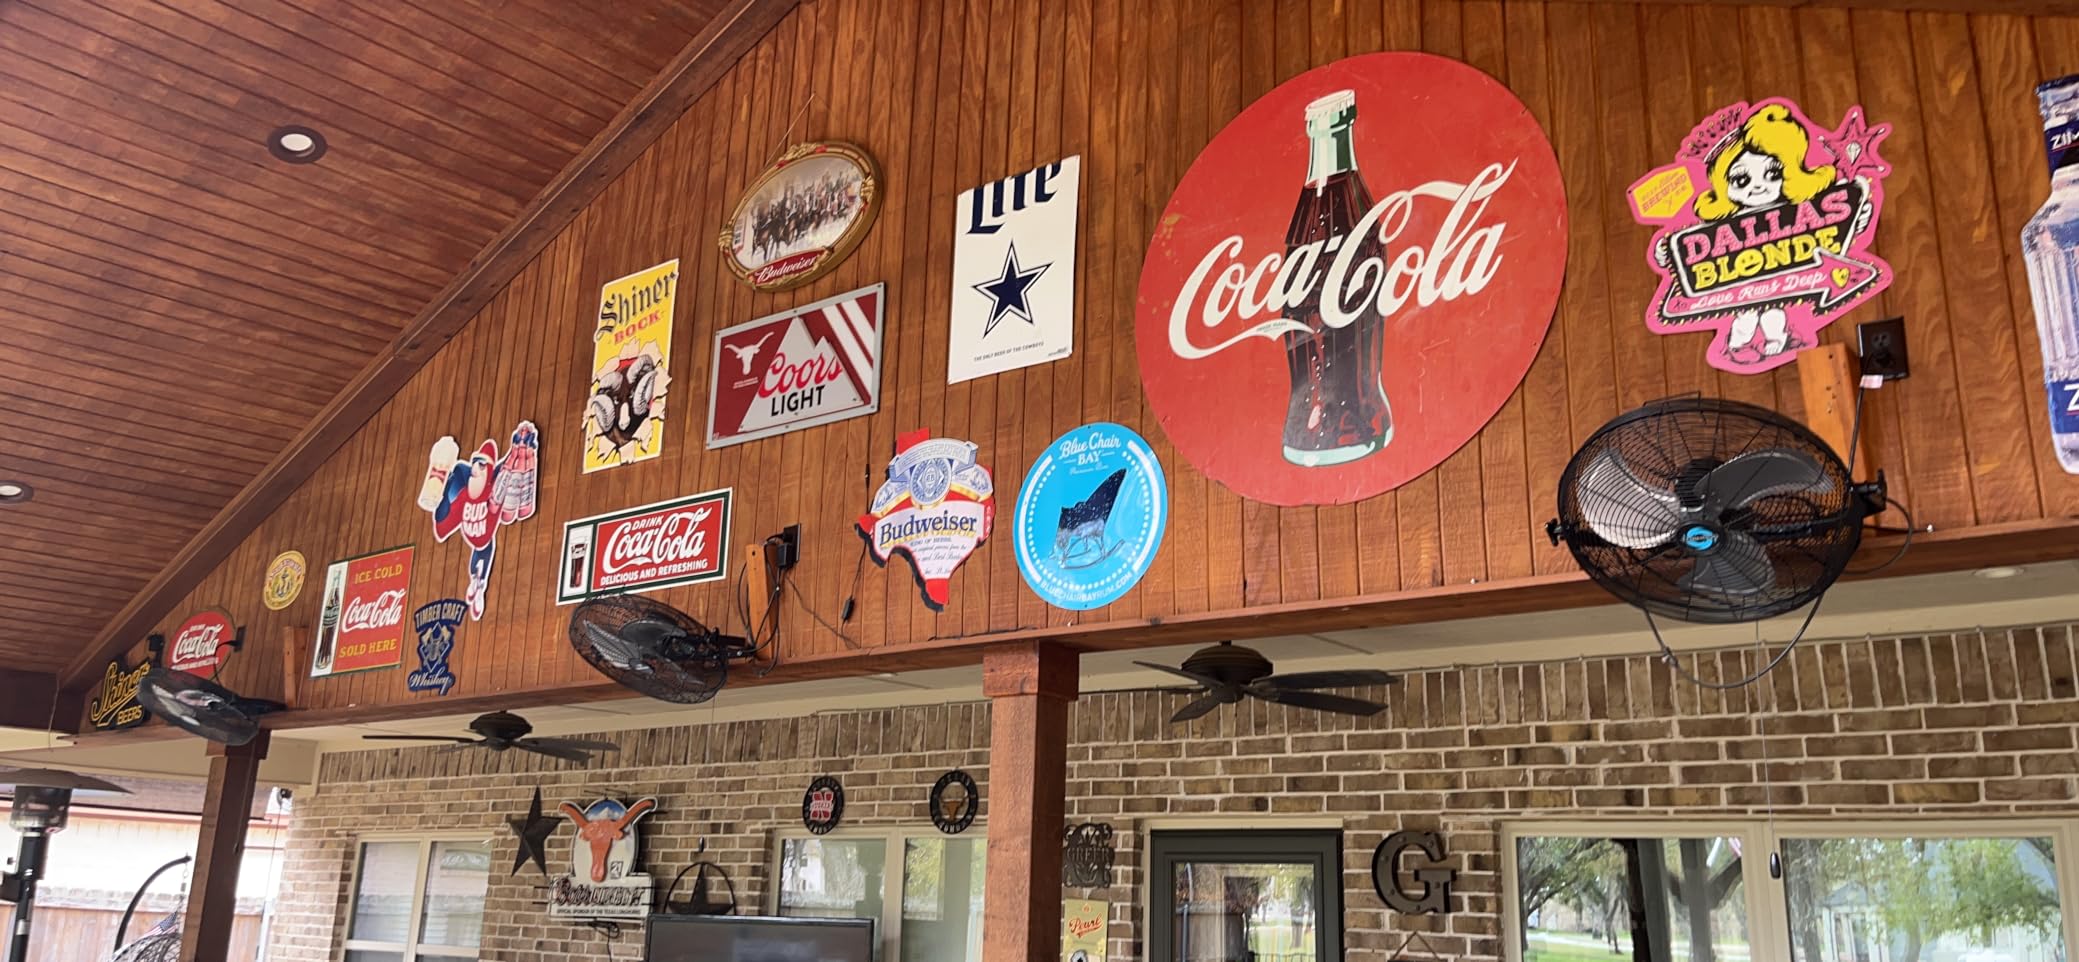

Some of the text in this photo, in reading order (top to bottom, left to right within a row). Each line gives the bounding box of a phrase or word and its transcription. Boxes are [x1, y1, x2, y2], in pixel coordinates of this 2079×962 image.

[1682, 190, 1852, 265] DALLAS
[755, 256, 817, 283] Budweiser
[1169, 157, 1519, 360] Coca-Cola
[596, 271, 676, 341] Shiner
[1690, 270, 1828, 311] Love Runs Deep
[614, 309, 660, 345] BOCK
[758, 352, 844, 398] Coors
[771, 385, 826, 417] LIGHT
[1058, 431, 1121, 459] Blue Chair
[1078, 450, 1101, 466] BAY
[462, 501, 489, 522] BUD
[631, 515, 663, 531] DRINK
[462, 520, 487, 537] MAN
[602, 507, 712, 574] Coca-Cola
[880, 510, 977, 547] Budweiser
[355, 564, 403, 584] ICE COLD
[600, 558, 708, 586] DELICIOUS AND REFRESHING
[341, 588, 406, 633] Coca-Cola
[415, 602, 467, 627] TIMBER CRAFT
[172, 623, 225, 663] Coca-Cola
[338, 638, 398, 659] SOLD HERE
[410, 665, 450, 696] Whiskey
[116, 705, 142, 725] BEERS
[1371, 829, 1457, 916] G
